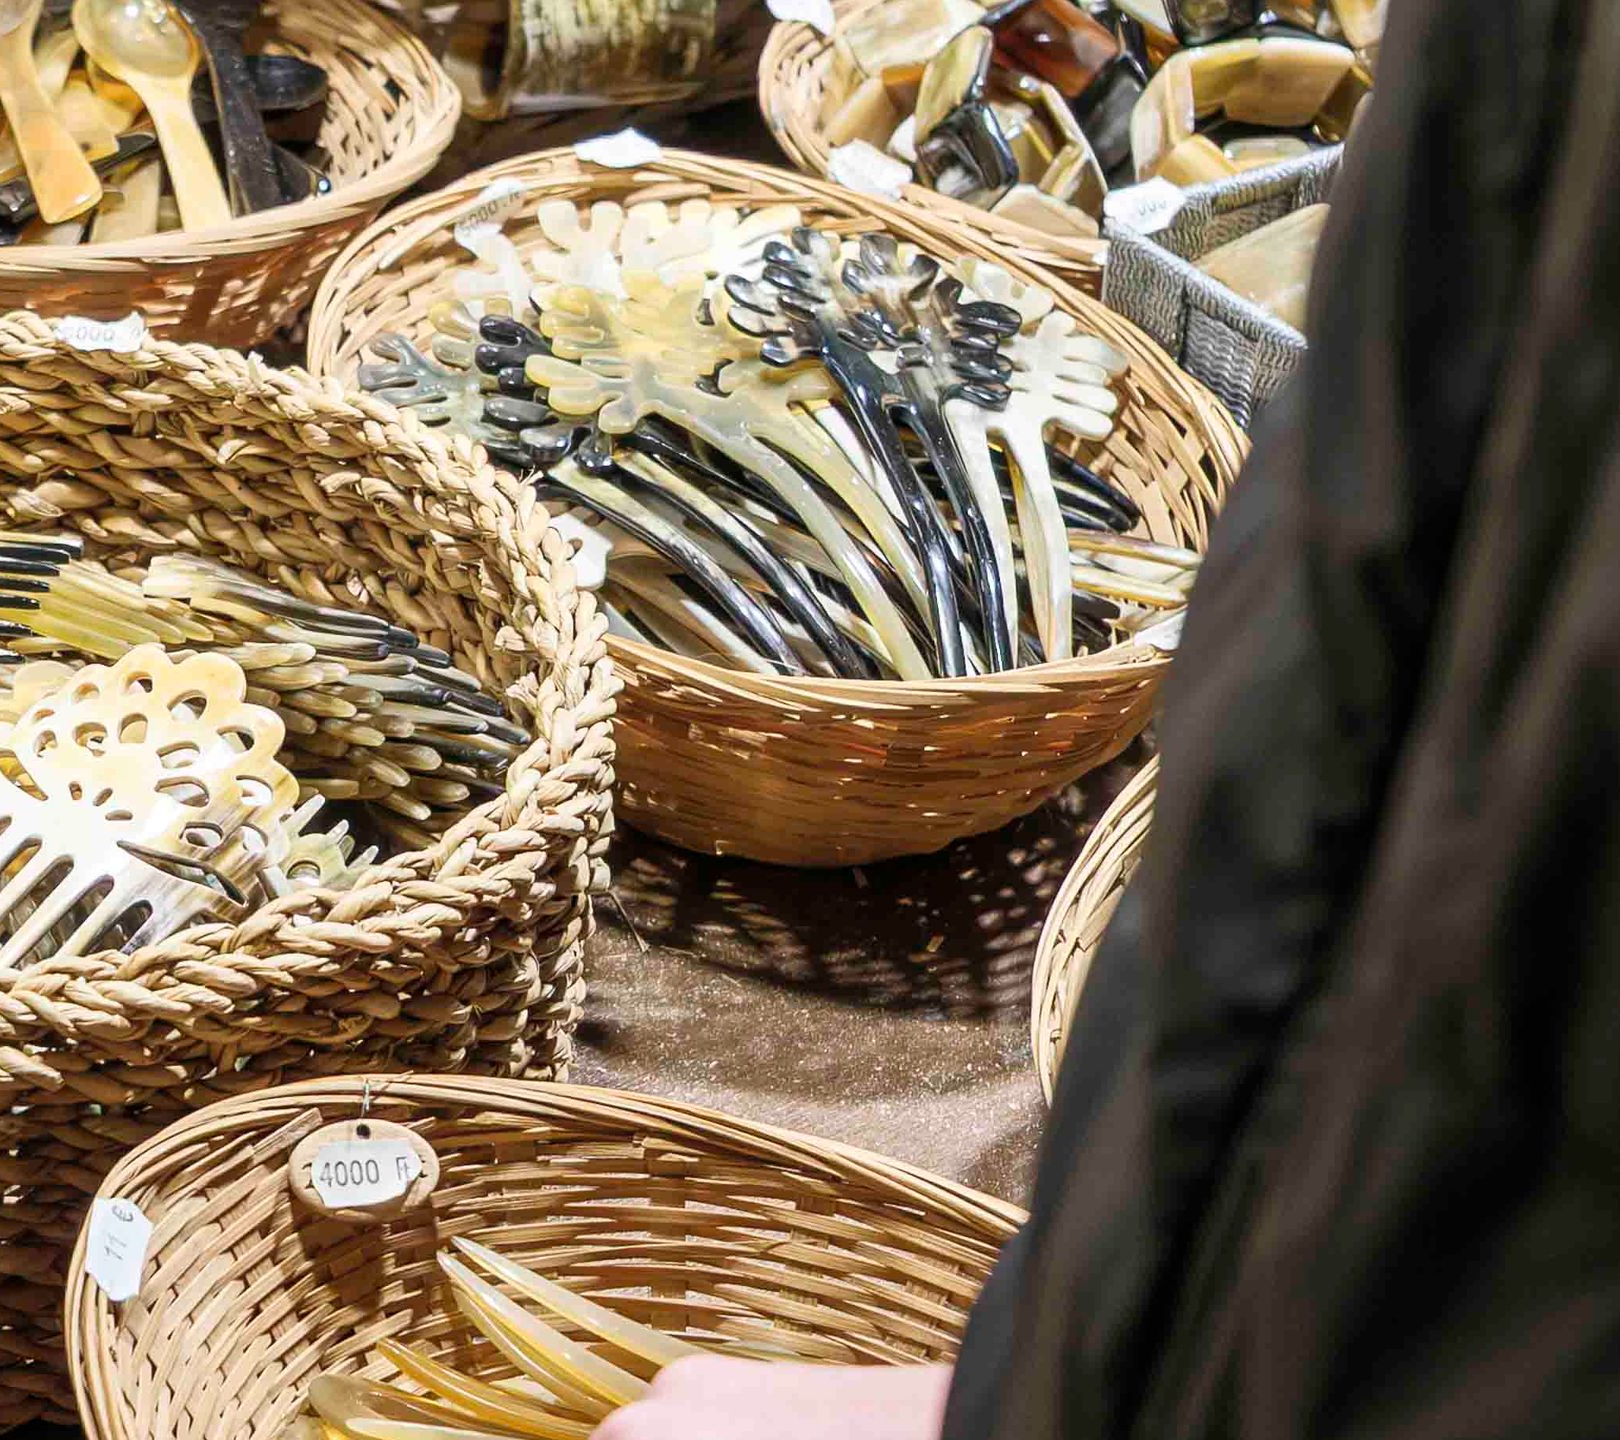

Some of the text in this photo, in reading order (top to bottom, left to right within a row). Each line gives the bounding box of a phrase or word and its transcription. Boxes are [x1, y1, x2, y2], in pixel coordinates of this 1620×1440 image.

[319, 1158, 381, 1189] 4000
[103, 1204, 135, 1262] 11 €
